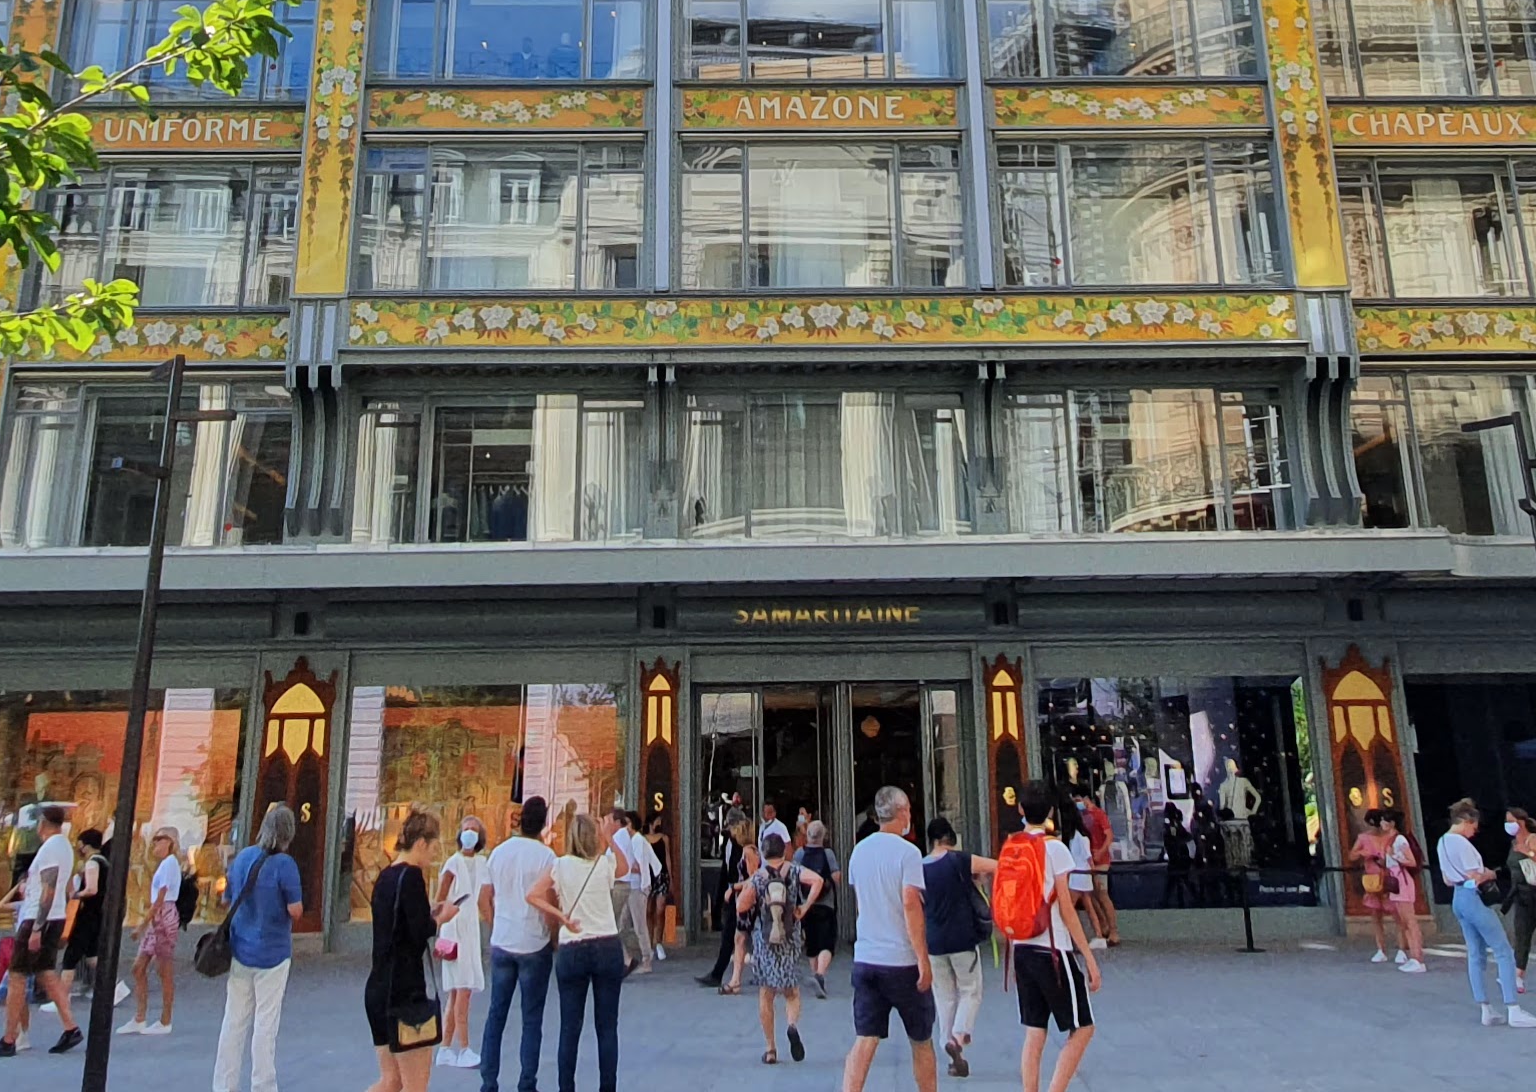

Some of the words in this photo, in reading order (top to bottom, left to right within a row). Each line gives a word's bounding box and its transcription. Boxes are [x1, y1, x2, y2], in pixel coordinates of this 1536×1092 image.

[734, 96, 906, 120] AMAZONE
[104, 117, 272, 143] UNIFORME
[1345, 110, 1526, 138] CHAPEAUX
